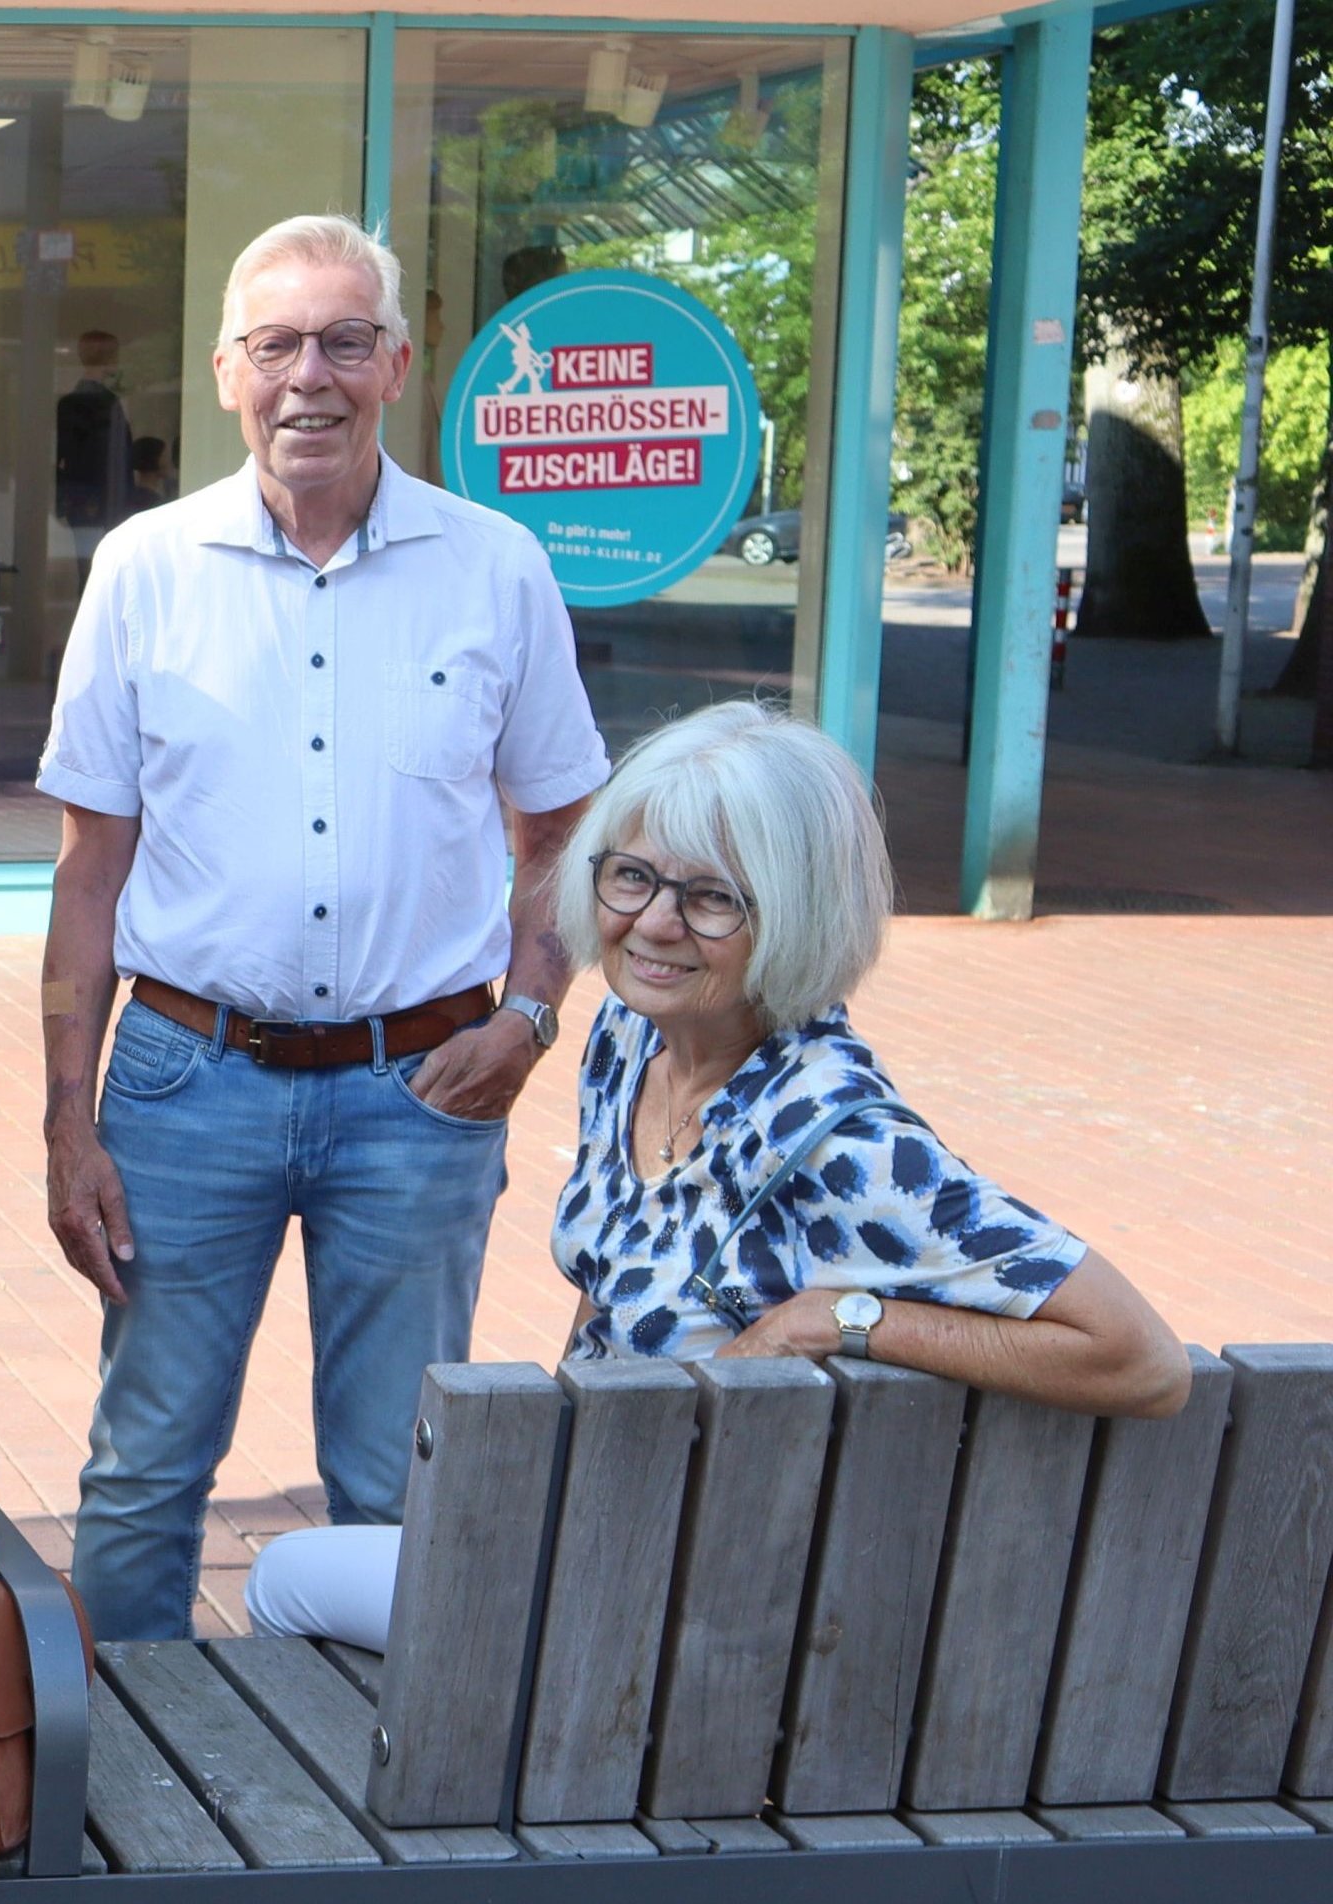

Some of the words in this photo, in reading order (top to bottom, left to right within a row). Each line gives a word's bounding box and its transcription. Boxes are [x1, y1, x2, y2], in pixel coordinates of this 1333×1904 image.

[557, 348, 648, 384] KEINE
[483, 394, 721, 437] ÜBERGRÖSSEN-
[504, 443, 696, 488] ZUSCHLÄGE!
[545, 541, 663, 564] BRUNO-KLEINE.DE
